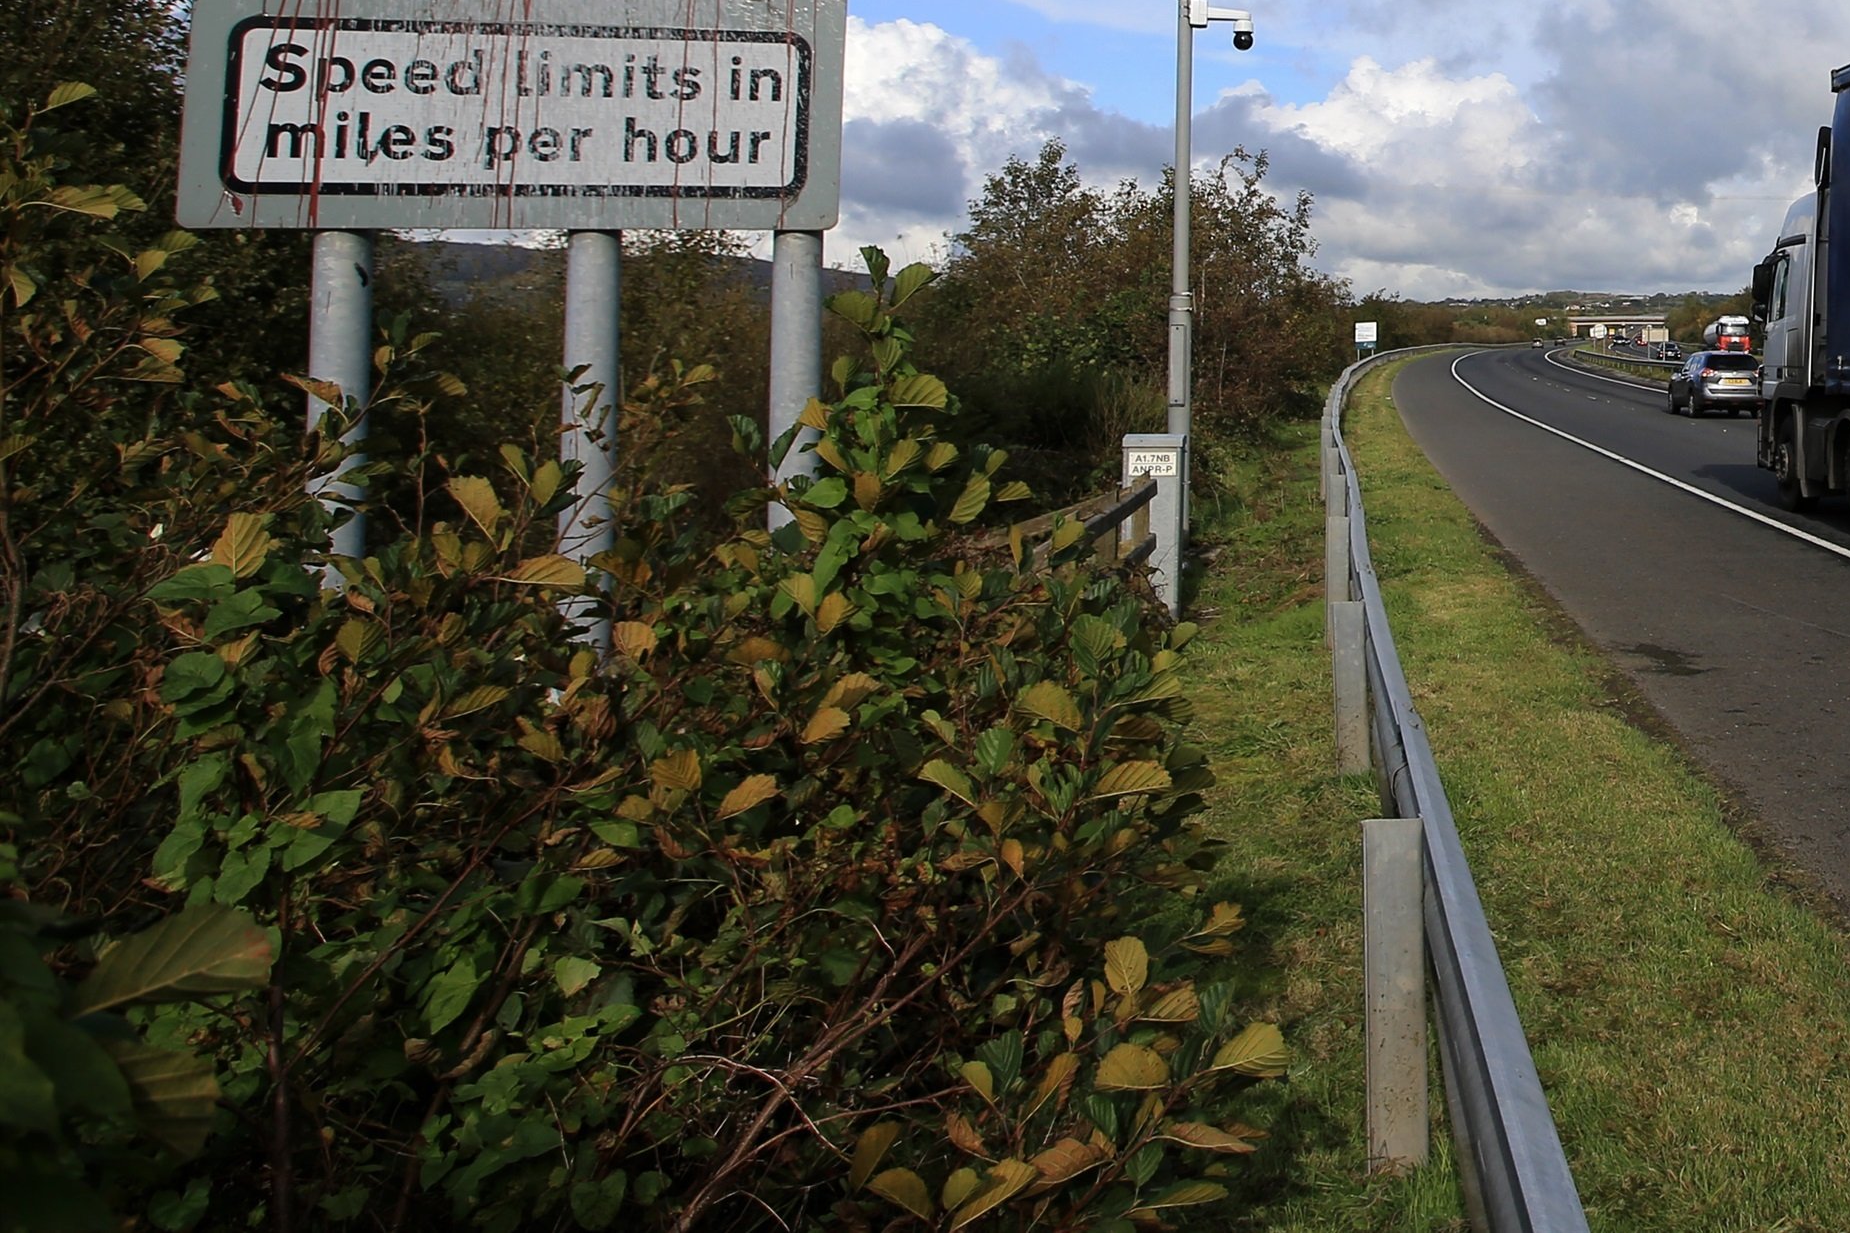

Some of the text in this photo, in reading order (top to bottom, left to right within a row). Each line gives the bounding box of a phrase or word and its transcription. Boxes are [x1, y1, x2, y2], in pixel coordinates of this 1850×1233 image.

[258, 42, 784, 105] Speed limits in
[266, 109, 771, 171] miles per hour
[1135, 454, 1170, 462] A1.7NB
